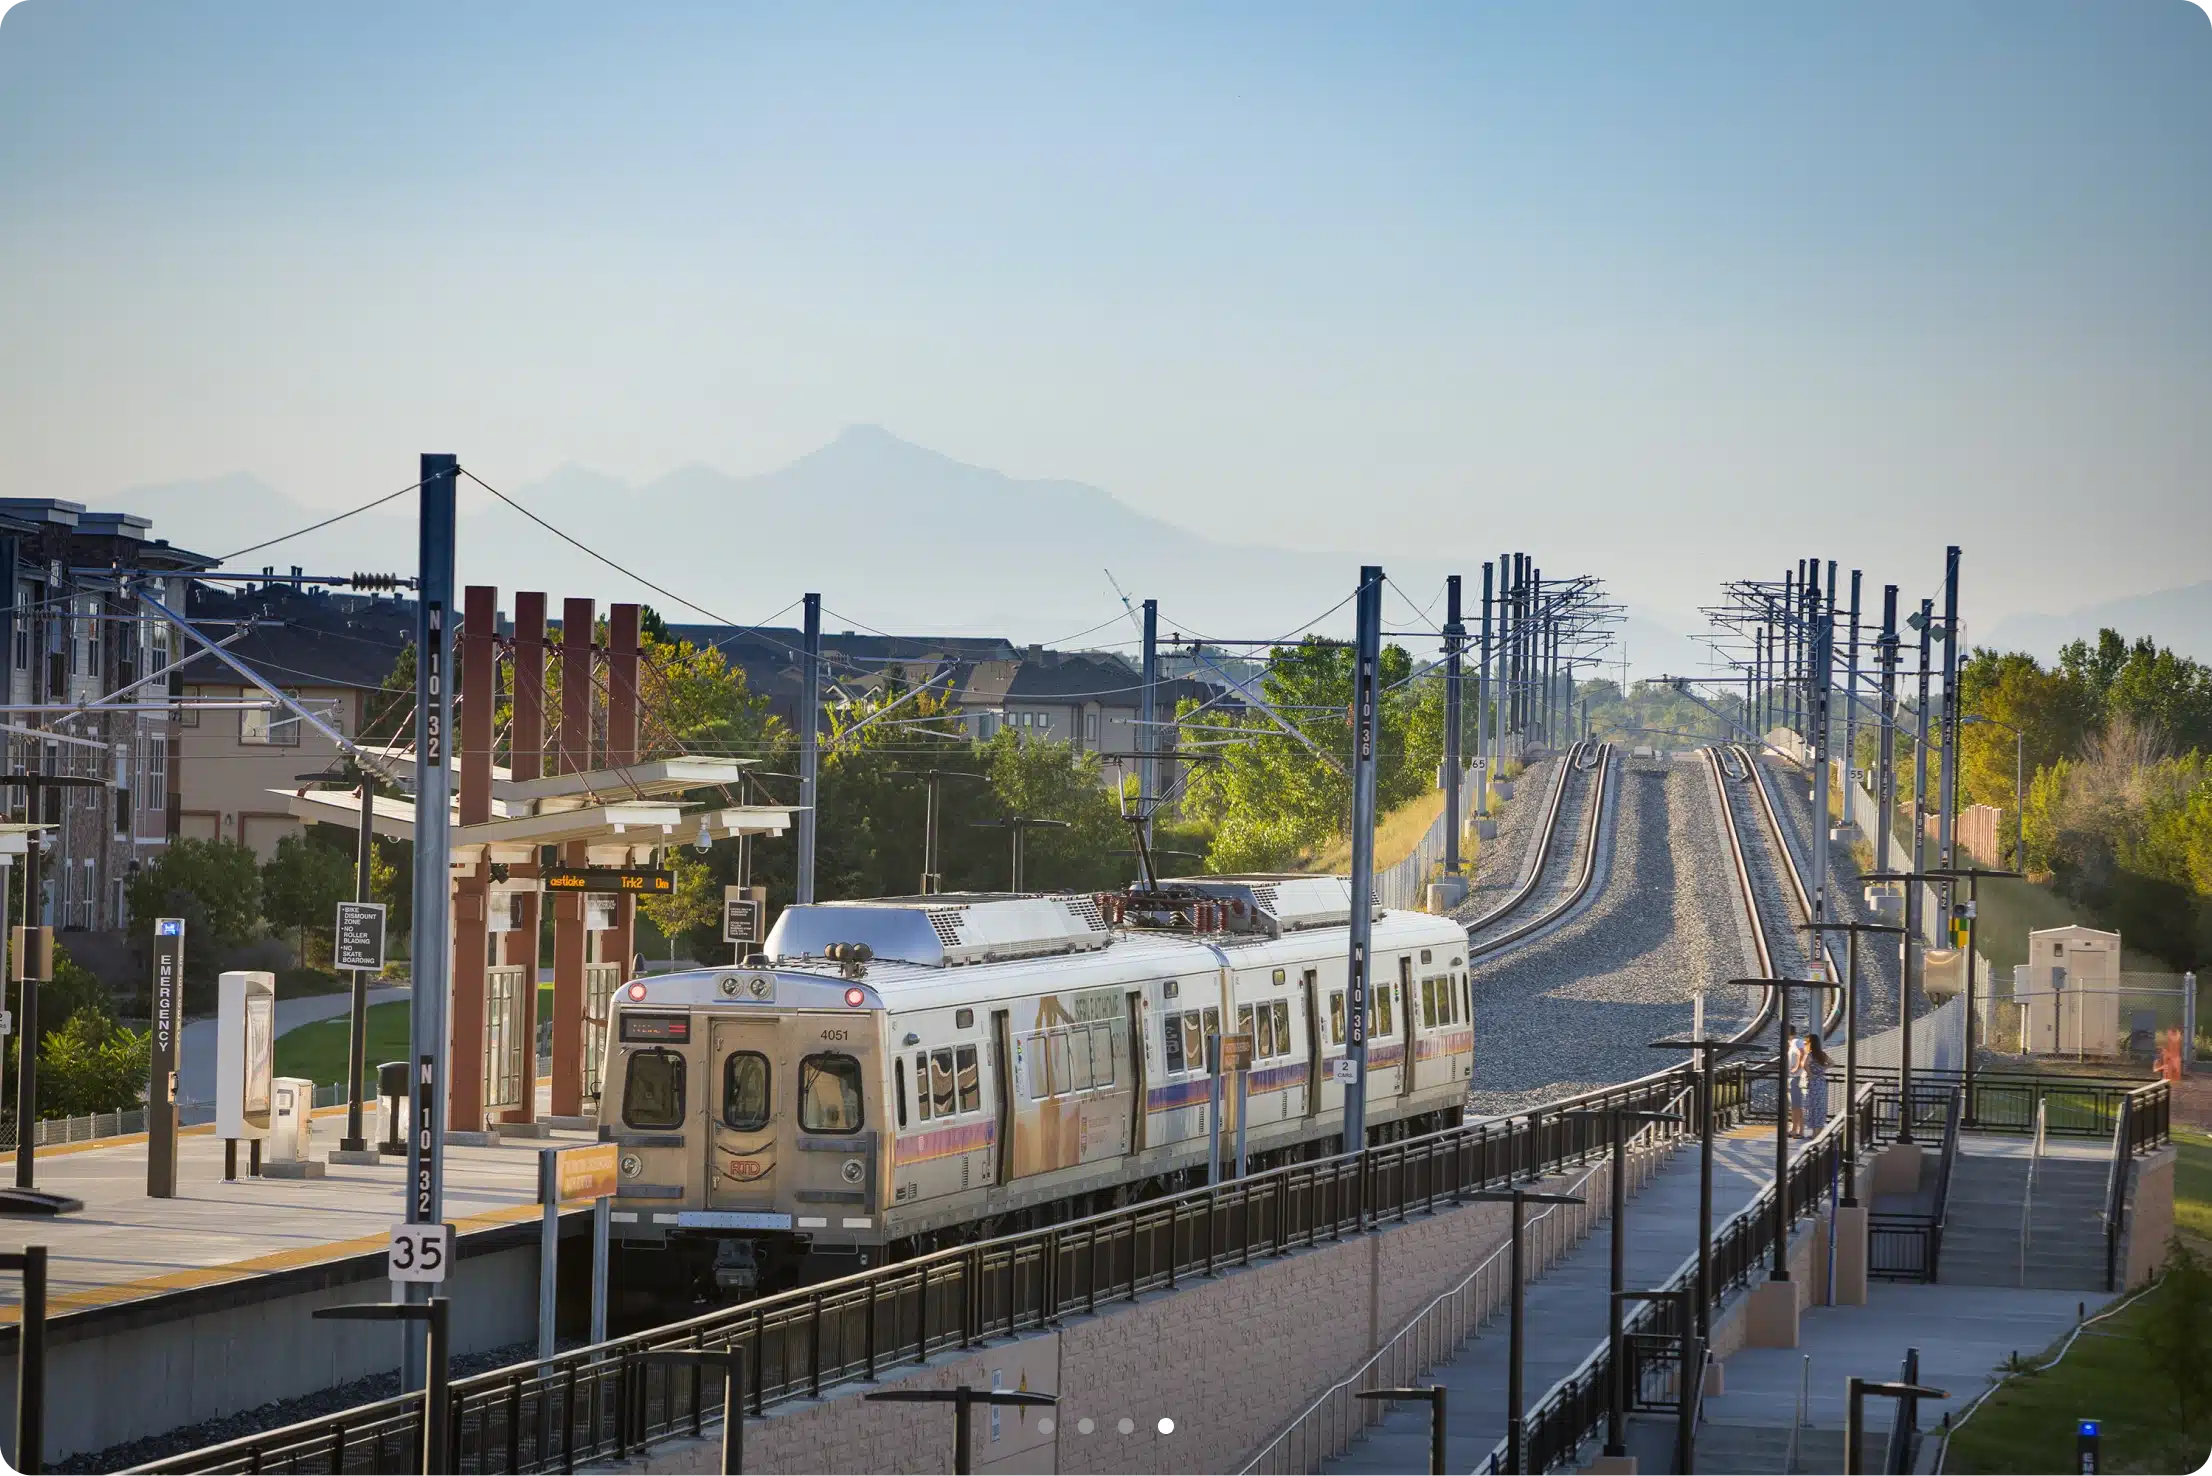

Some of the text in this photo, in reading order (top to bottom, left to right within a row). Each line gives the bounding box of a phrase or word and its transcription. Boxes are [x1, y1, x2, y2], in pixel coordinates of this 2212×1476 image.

[430, 610, 441, 630] N
[1364, 663, 1371, 675] N
[1472, 760, 1485, 768] 65
[1850, 770, 1864, 779] 55
[550, 875, 585, 887] astlake
[621, 876, 643, 888] Trk2
[344, 912, 376, 920] DISMOUNT
[159, 955, 171, 1052] EMERGENCY
[820, 1029, 848, 1041] 4051
[1342, 1062, 1349, 1071] 2
[419, 1064, 432, 1213] N 10-32
[731, 1160, 761, 1176] RTD
[392, 1236, 442, 1271] 35
